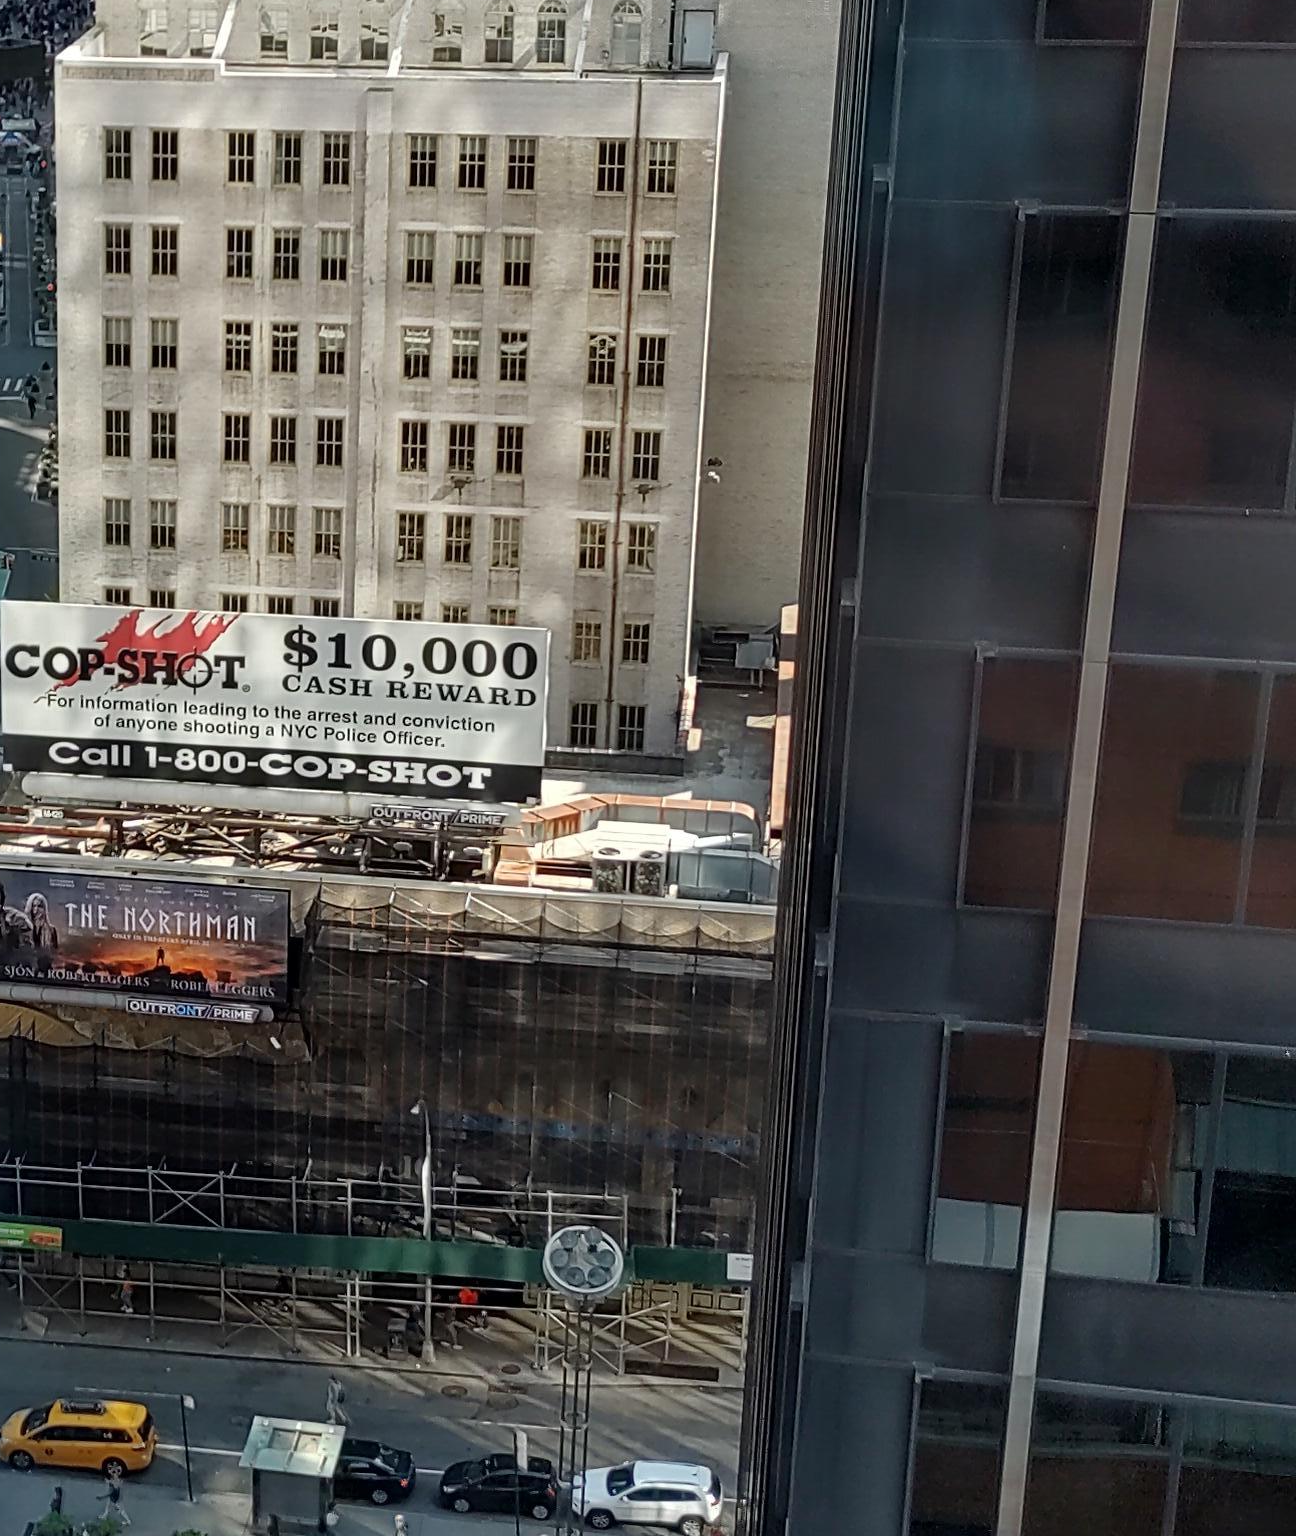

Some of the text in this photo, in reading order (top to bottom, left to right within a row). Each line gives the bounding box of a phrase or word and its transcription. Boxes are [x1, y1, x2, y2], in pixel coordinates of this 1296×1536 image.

[5, 644, 246, 695] COP-SHOT
[283, 624, 538, 680] $10,000
[282, 673, 537, 707] CASH REWARD
[47, 693, 496, 732] For information leading to the arrest and conviction
[94, 715, 446, 748] of anyone shooting a NYC Police Officer.
[48, 741, 492, 791] Call 1-800-COP-SHOT
[373, 807, 502, 825] OUTFRONT PRIME
[65, 903, 256, 943] THE NORTHMAN
[47, 969, 97, 983] ROBERT
[99, 972, 150, 988] EGGERS
[170, 978, 218, 994] ROBERT
[218, 981, 276, 998] EGGERS
[129, 1001, 255, 1021] OUTFRONT PRIME
